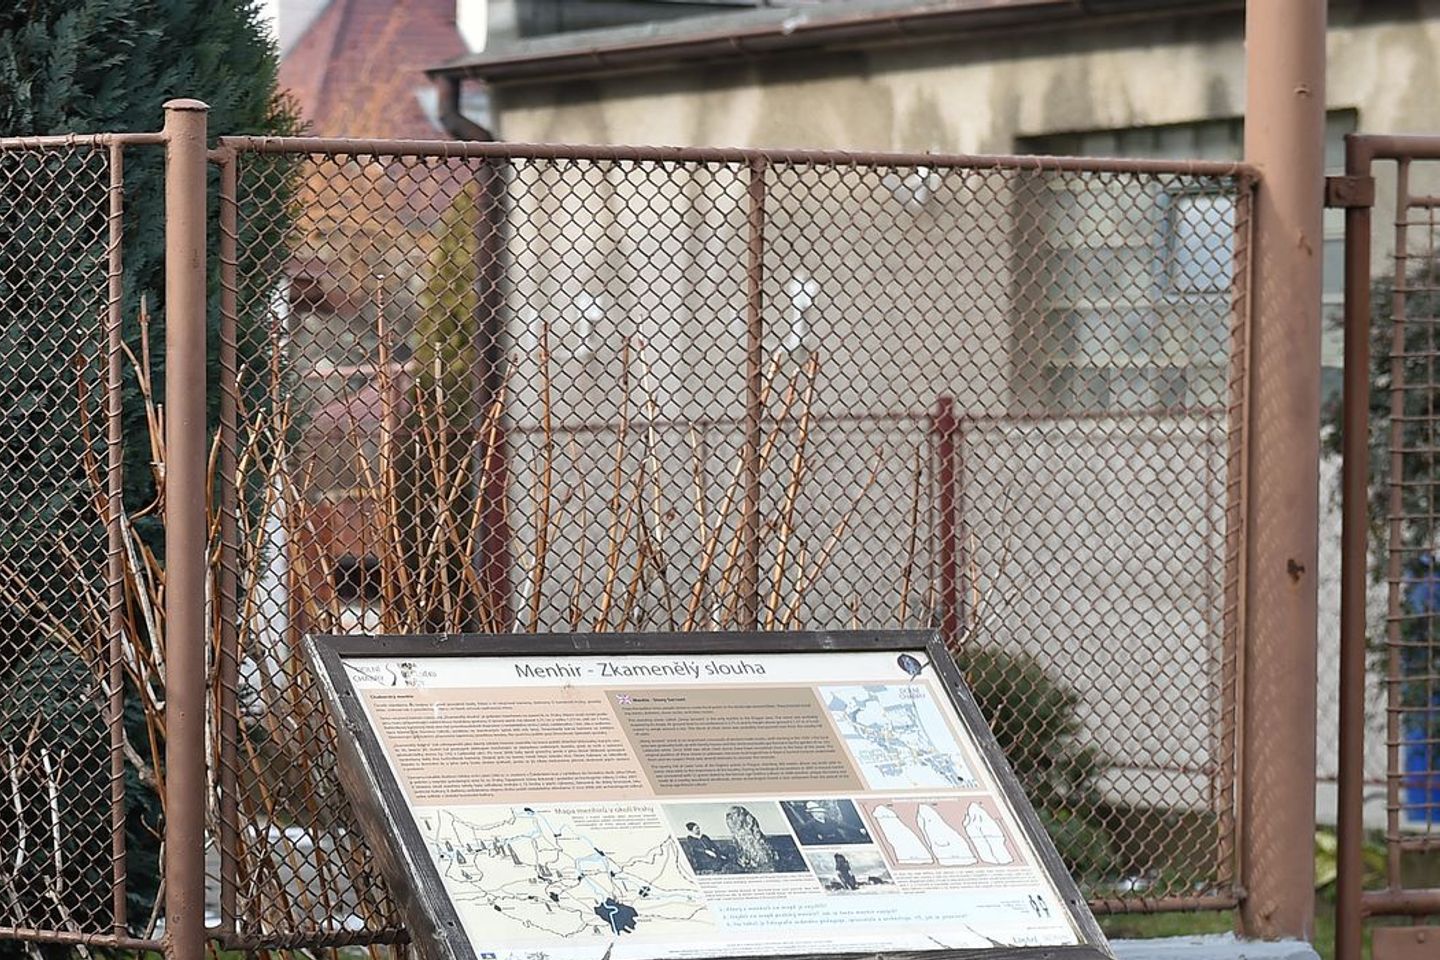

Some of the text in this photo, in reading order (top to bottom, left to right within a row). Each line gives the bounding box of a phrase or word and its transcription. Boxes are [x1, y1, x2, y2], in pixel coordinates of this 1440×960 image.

[514, 662, 582, 679] Menhir
[596, 660, 701, 680] Zkamenělý
[704, 659, 768, 676] slouha
